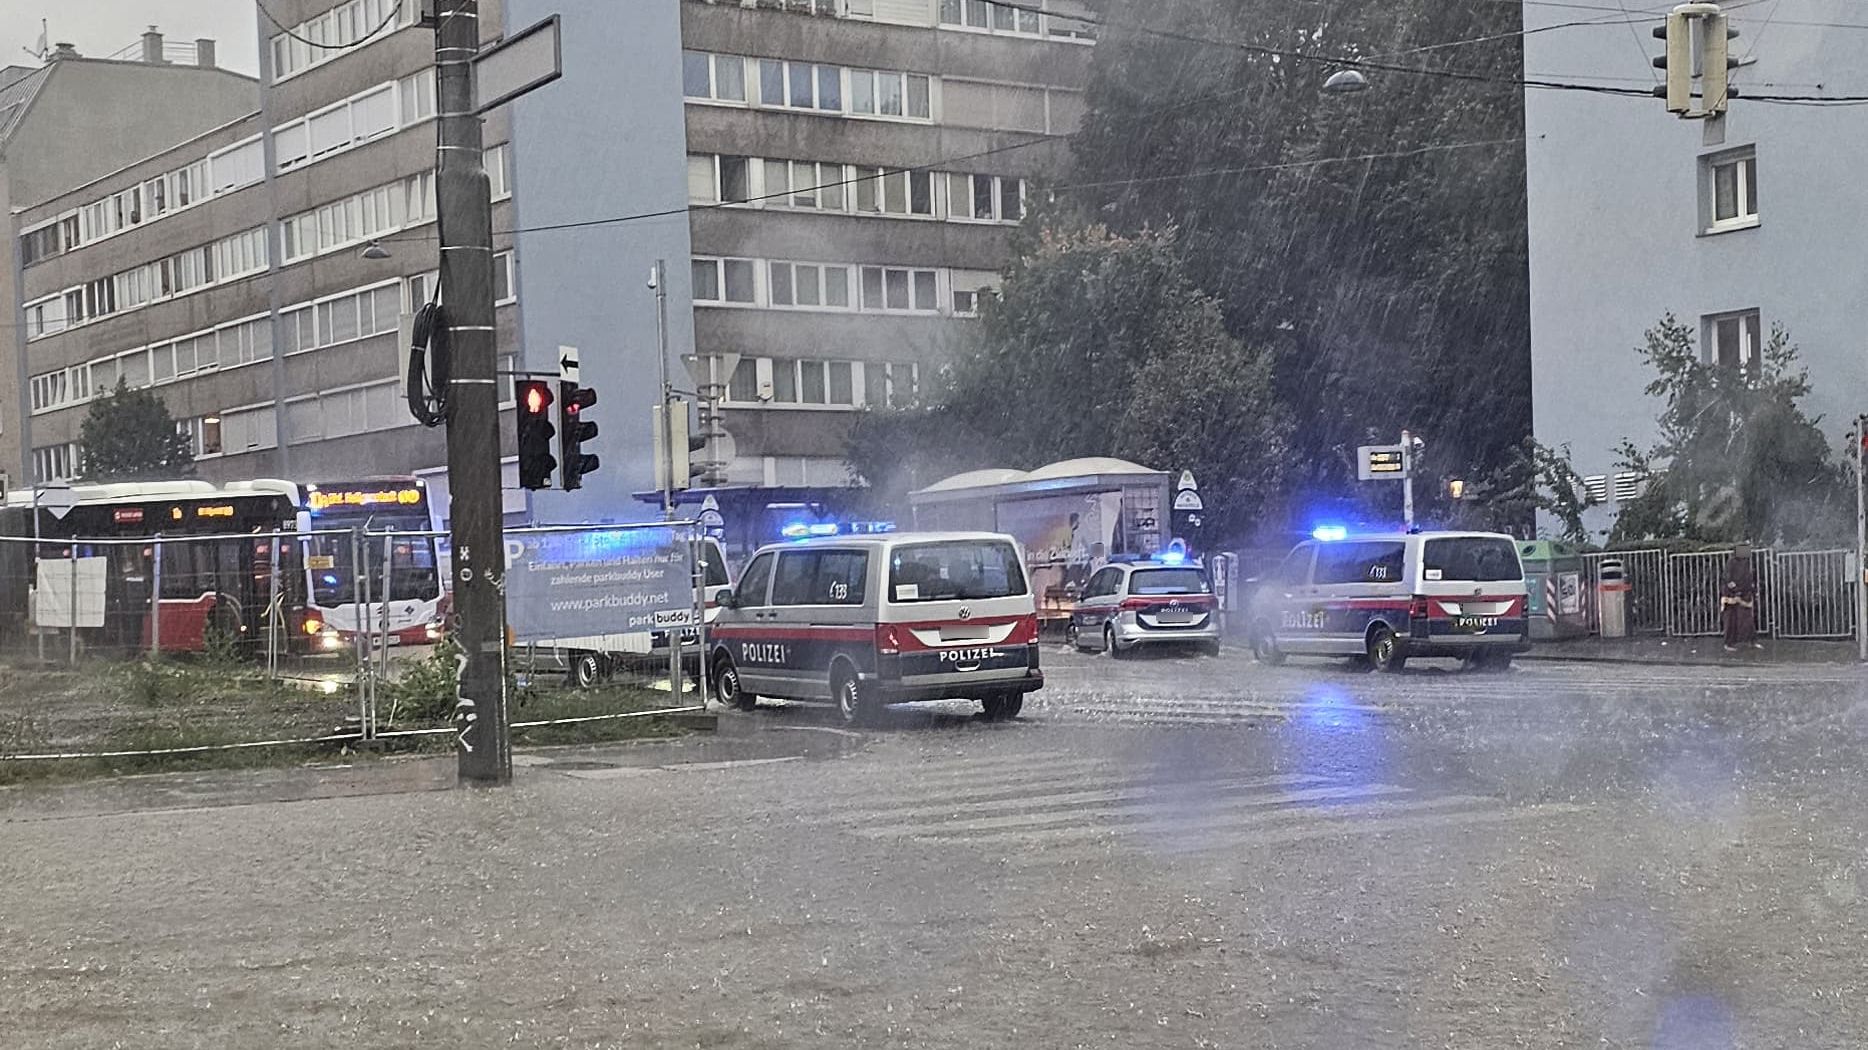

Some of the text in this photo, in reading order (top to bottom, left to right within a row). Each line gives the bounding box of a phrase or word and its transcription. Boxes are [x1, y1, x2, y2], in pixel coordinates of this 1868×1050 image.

[504, 540, 525, 569] P
[550, 591, 669, 611] www.parkbuddy.net
[741, 643, 786, 663] POLIZEI
[939, 647, 996, 662] POLIZEI
